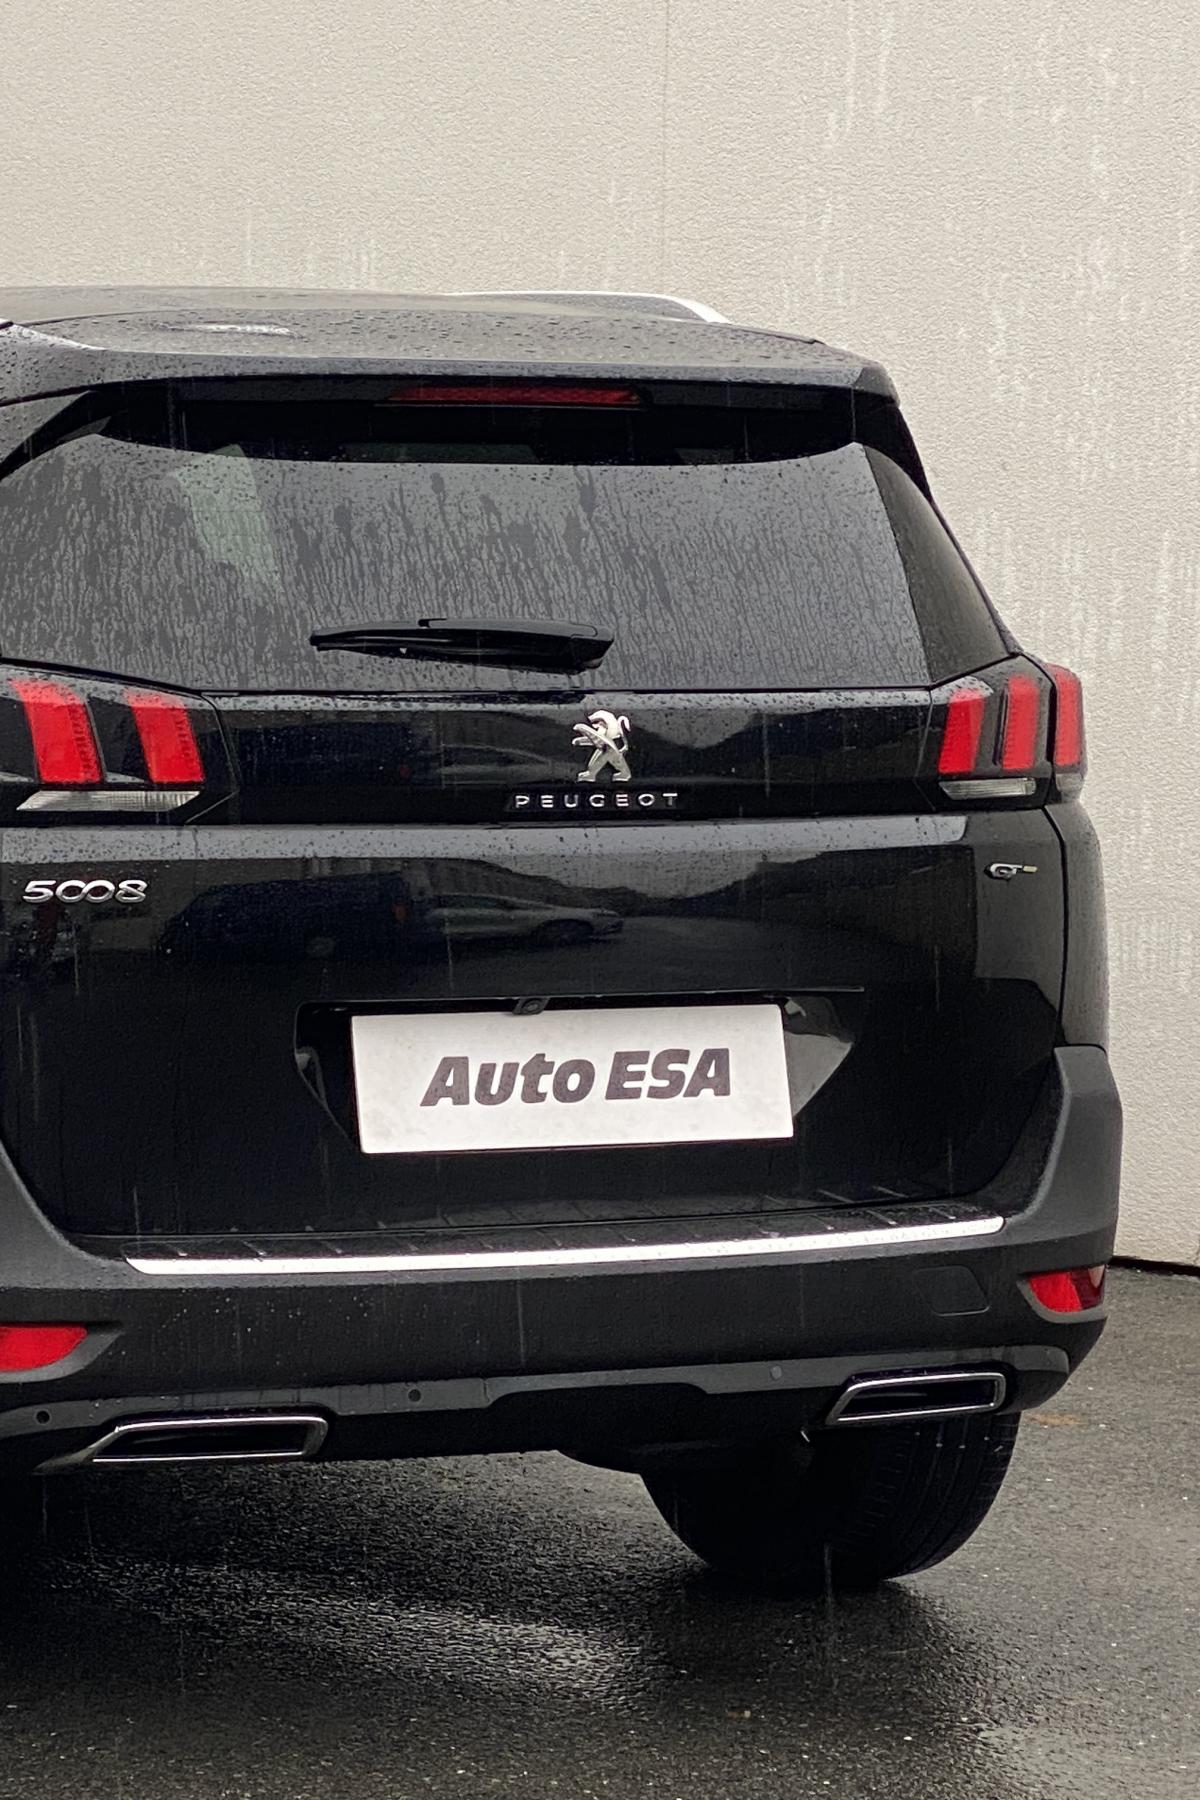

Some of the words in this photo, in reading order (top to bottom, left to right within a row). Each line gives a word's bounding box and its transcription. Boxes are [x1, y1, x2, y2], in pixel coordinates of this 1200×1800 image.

[514, 793, 678, 808] PEUGEOT
[22, 879, 148, 903] 5008
[420, 1053, 596, 1107] Auto
[605, 1048, 731, 1100] ESA
